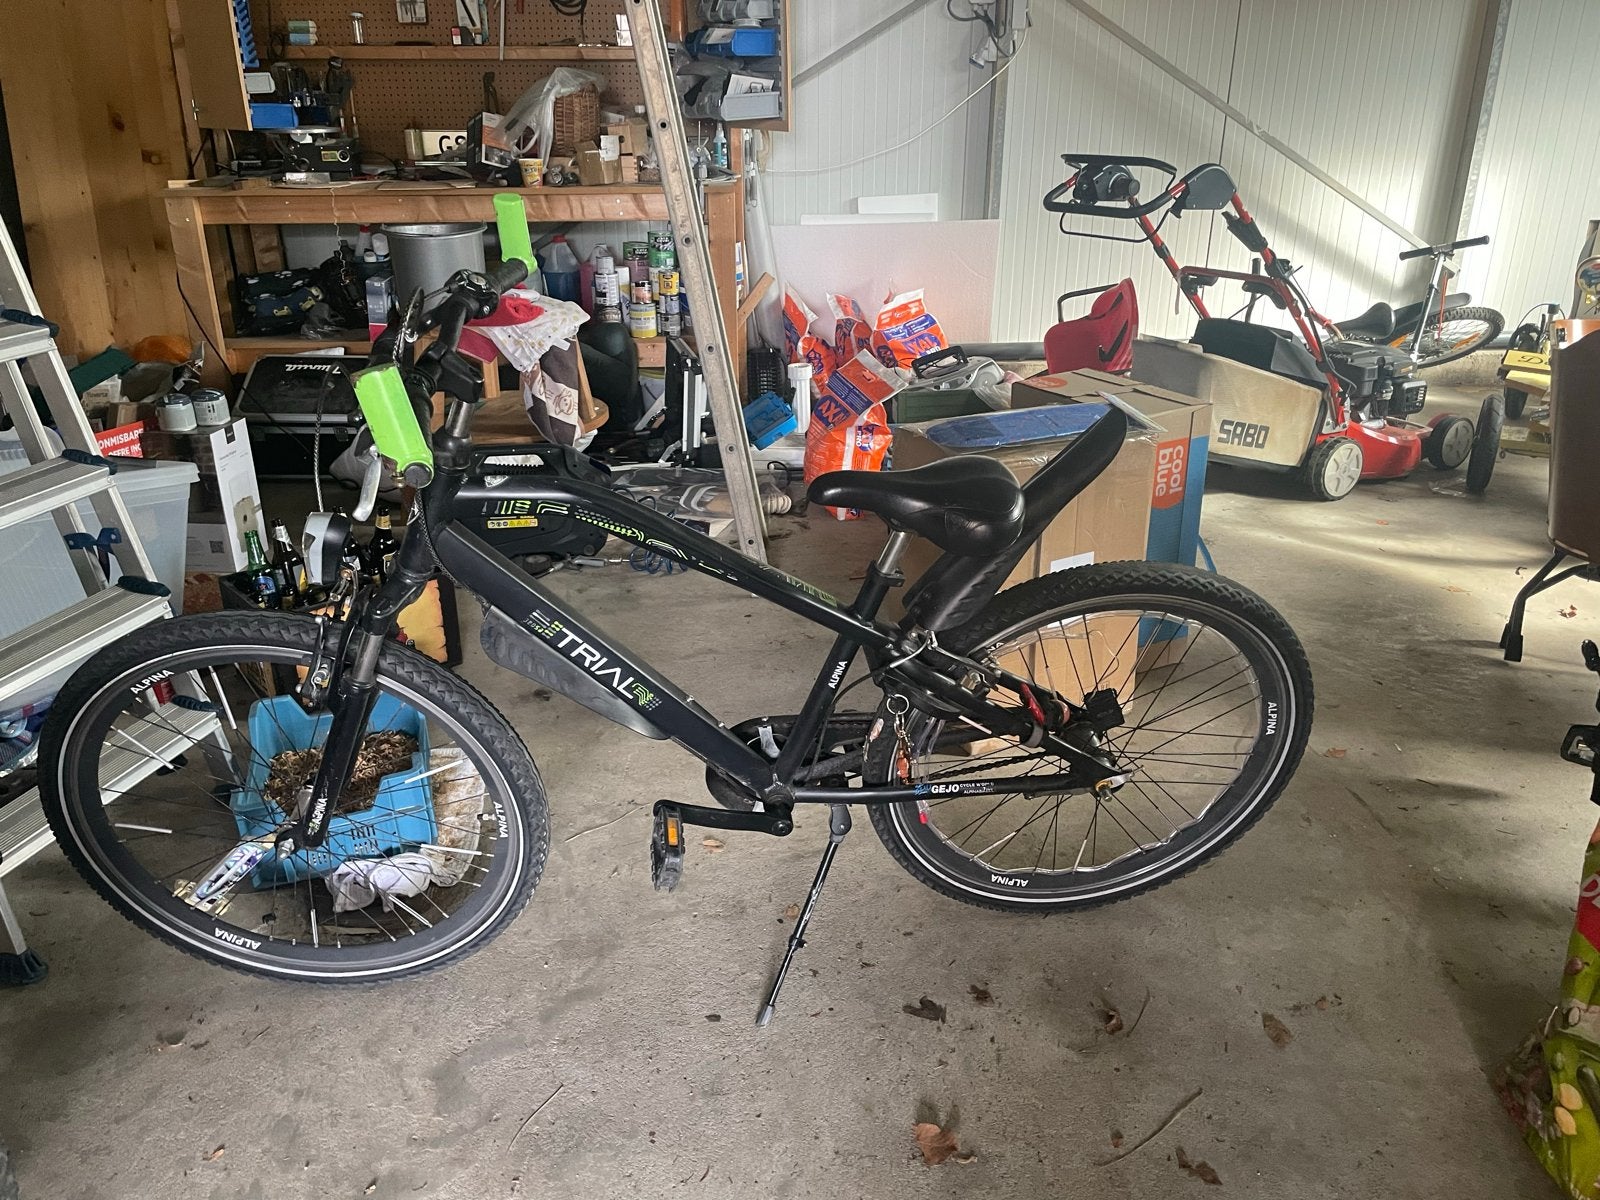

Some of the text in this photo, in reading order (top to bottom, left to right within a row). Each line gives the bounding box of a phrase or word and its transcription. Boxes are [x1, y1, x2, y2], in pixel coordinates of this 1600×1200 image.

[1217, 418, 1270, 449] SABO
[1156, 447, 1173, 496] blue
[1169, 445, 1184, 494] cool
[557, 627, 634, 699] TRIAL
[828, 661, 847, 689] ALPINA
[130, 670, 175, 694] ALPINA
[1266, 702, 1277, 735] ALPINA
[931, 784, 959, 794] GEJO
[493, 801, 508, 837] ALPINA
[992, 874, 1028, 887] ALPINA
[215, 927, 262, 950] ALPINA
